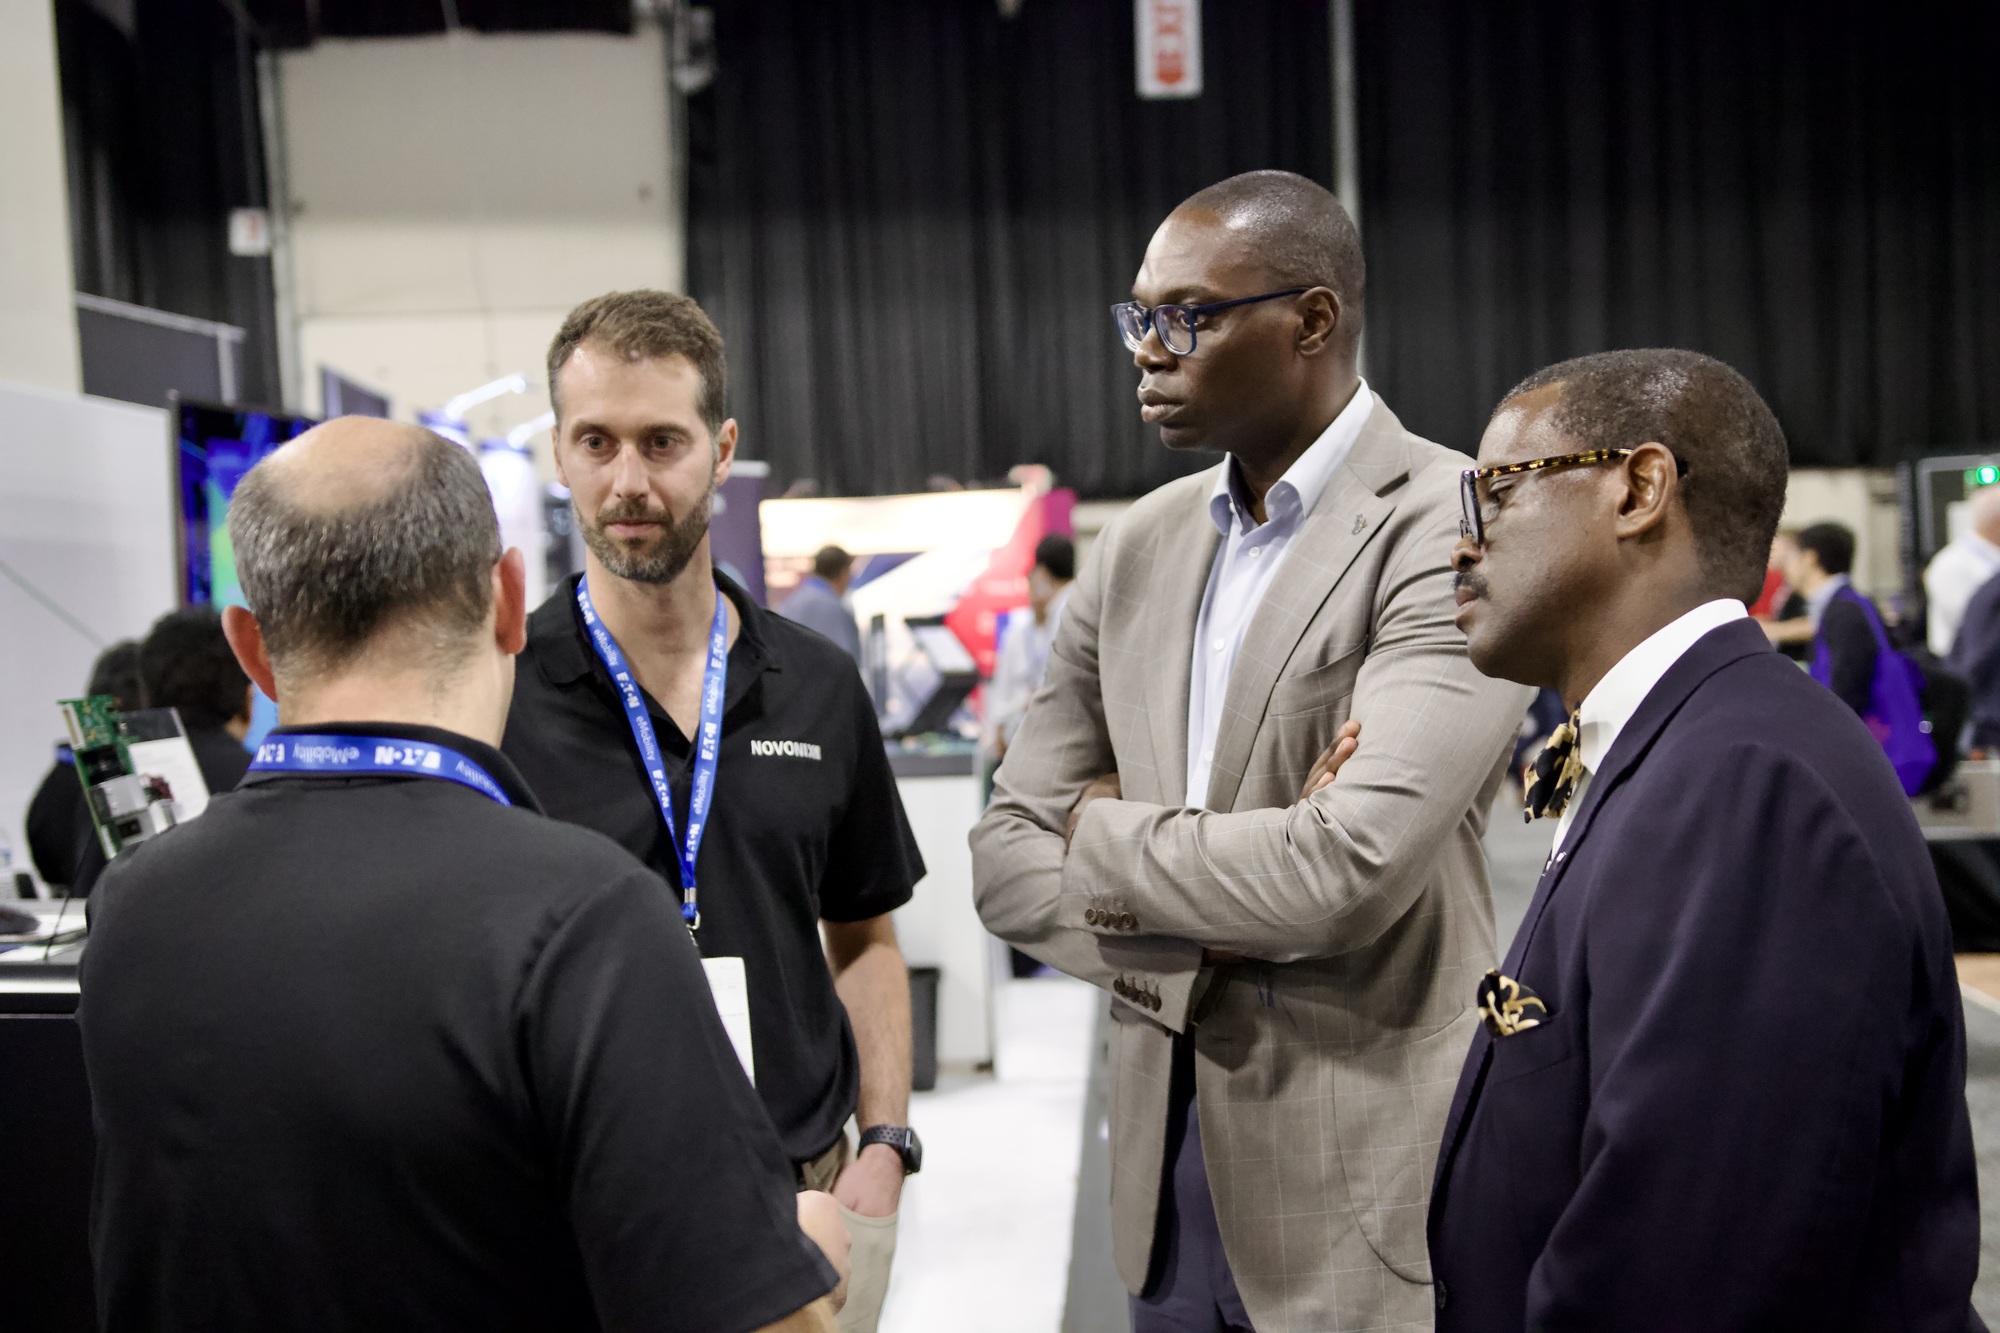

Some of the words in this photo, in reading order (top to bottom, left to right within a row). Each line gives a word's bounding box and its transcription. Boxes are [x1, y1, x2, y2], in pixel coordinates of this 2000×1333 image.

[594, 629, 619, 667] eMobility
[636, 716, 656, 761] eMobility
[292, 742, 360, 764] eMobility
[693, 769, 711, 815] eMobility
